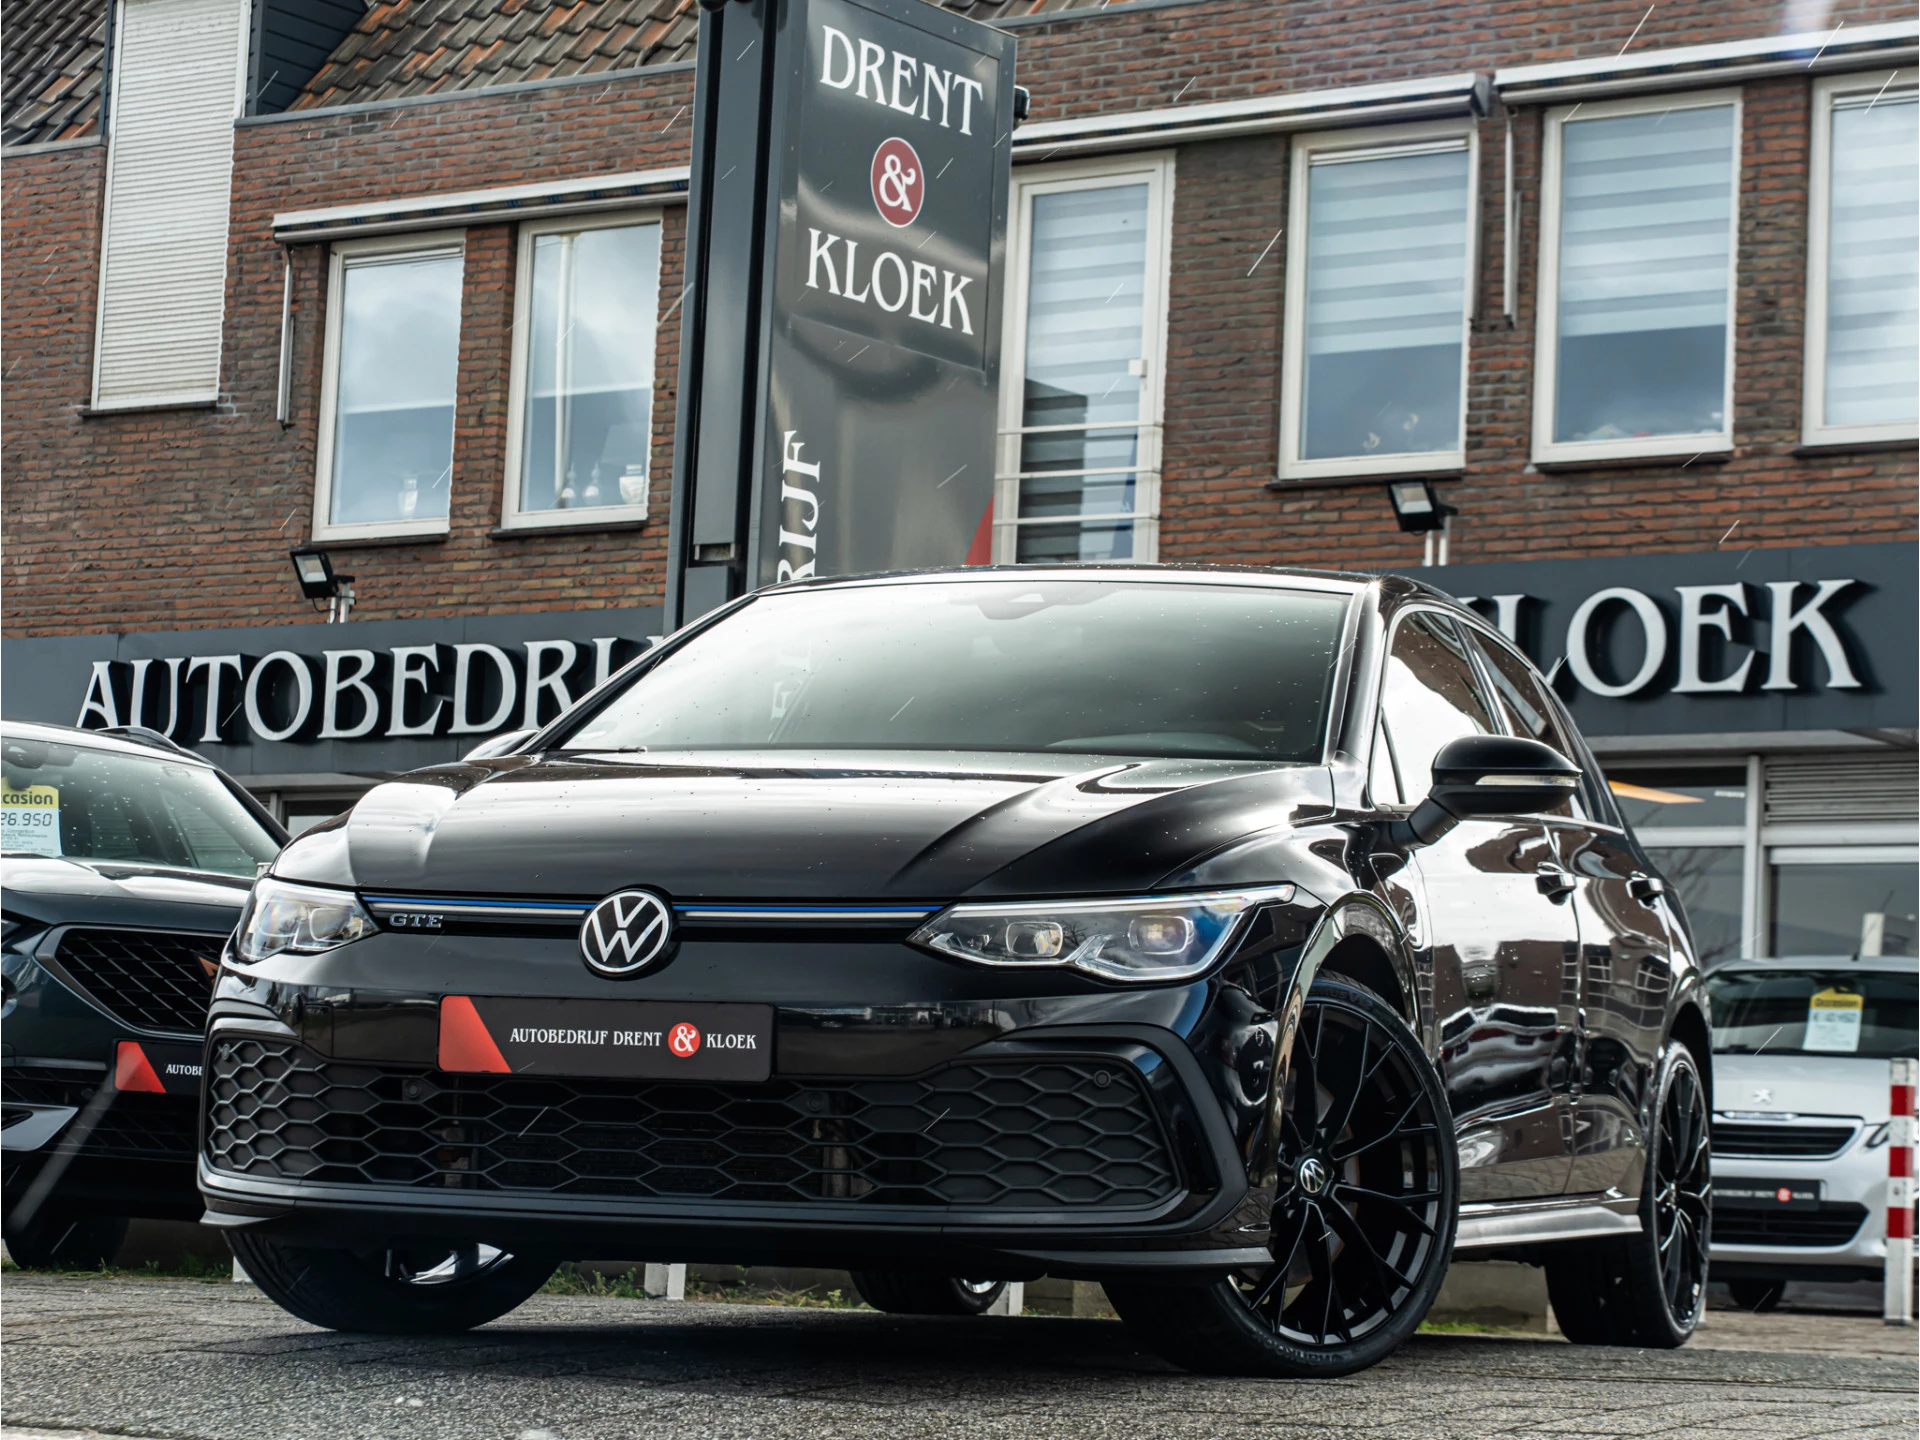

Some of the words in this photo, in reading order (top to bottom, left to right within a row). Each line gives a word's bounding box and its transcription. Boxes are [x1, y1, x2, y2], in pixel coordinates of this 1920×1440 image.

[820, 25, 984, 136] DRENT
[879, 154, 916, 213] &
[805, 228, 975, 336] KLOEK
[76, 635, 664, 743] AUTOBEDRI
[1, 791, 53, 805] casion
[389, 912, 444, 929] GTE
[510, 1028, 609, 1045] AUTOBEDRIJF
[612, 1030, 663, 1047] DRENT
[673, 1026, 697, 1052] &
[706, 1033, 757, 1050] KLOEK
